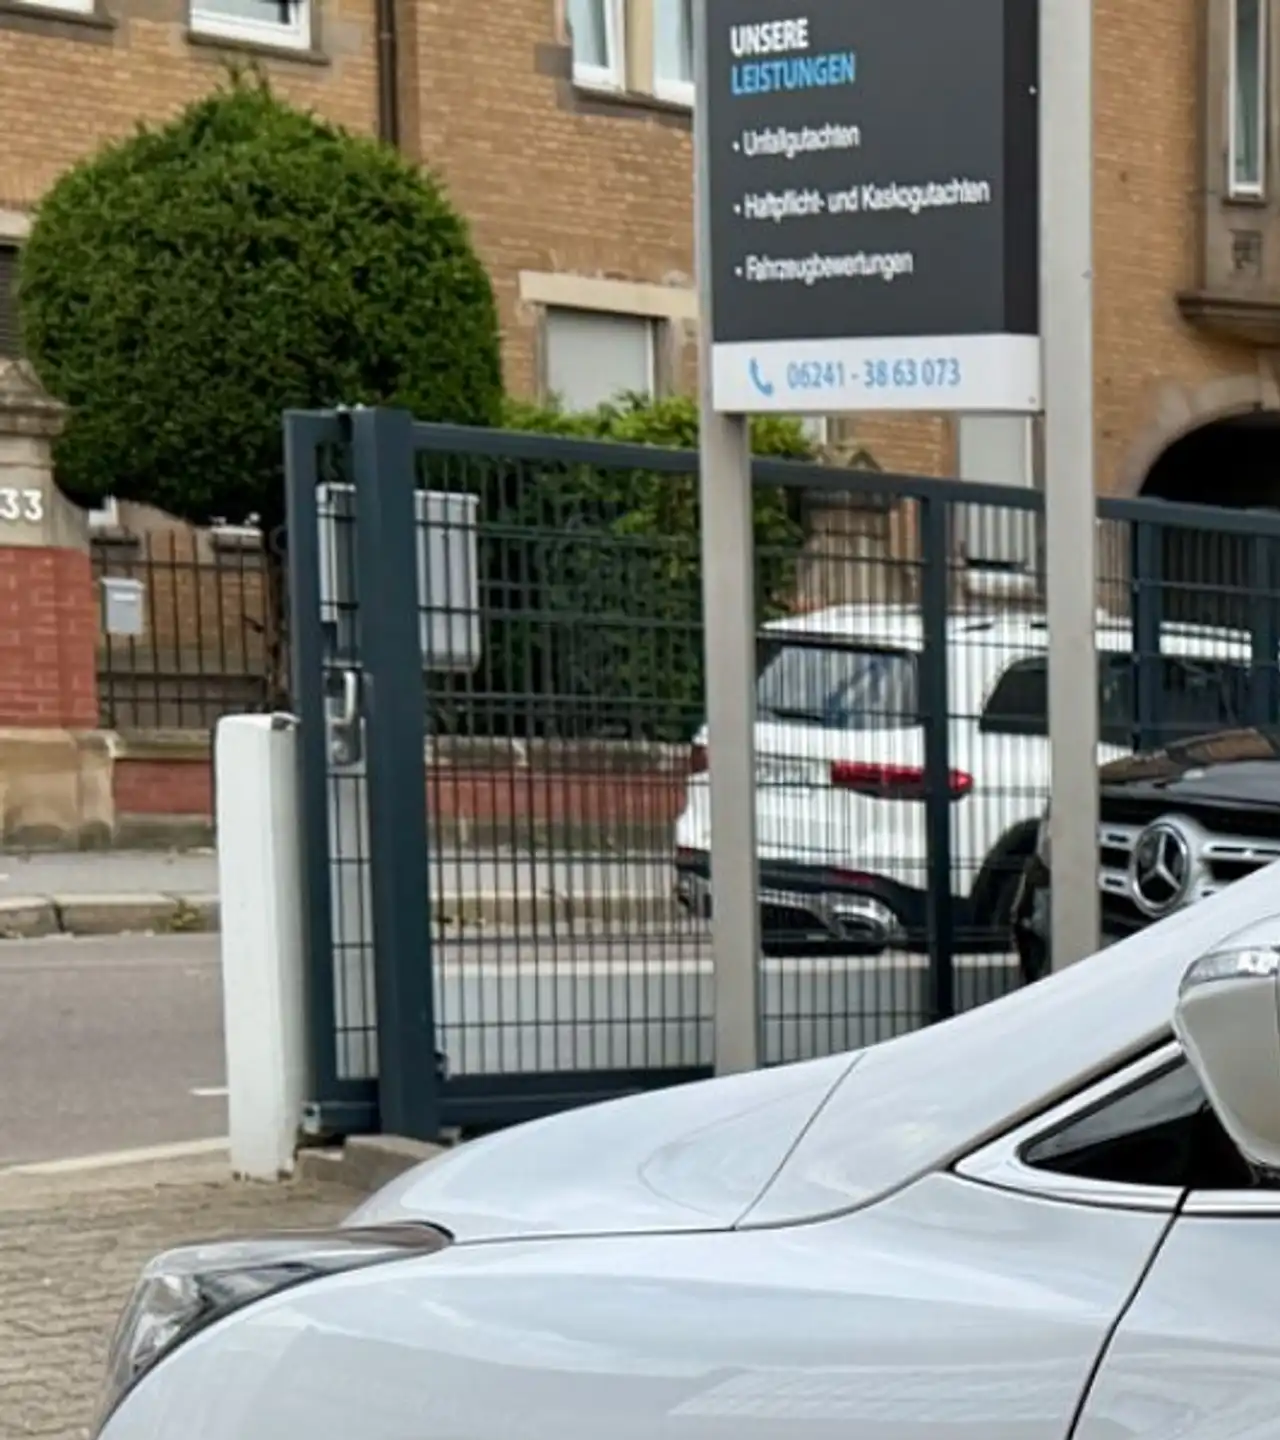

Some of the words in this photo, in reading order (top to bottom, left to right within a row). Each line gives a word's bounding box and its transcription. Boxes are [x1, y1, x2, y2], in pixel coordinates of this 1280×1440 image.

[730, 17, 809, 57] UNSERE
[732, 51, 856, 95] LEISTUNGEN
[743, 122, 861, 158] Unfallgutachten
[744, 188, 825, 223] Haftpflicht-
[828, 185, 858, 213] und
[862, 178, 991, 215] Kaskogutachten
[745, 251, 914, 285] Fahrzeugbewertungen
[786, 360, 845, 390] 06241
[922, 356, 962, 388] 073
